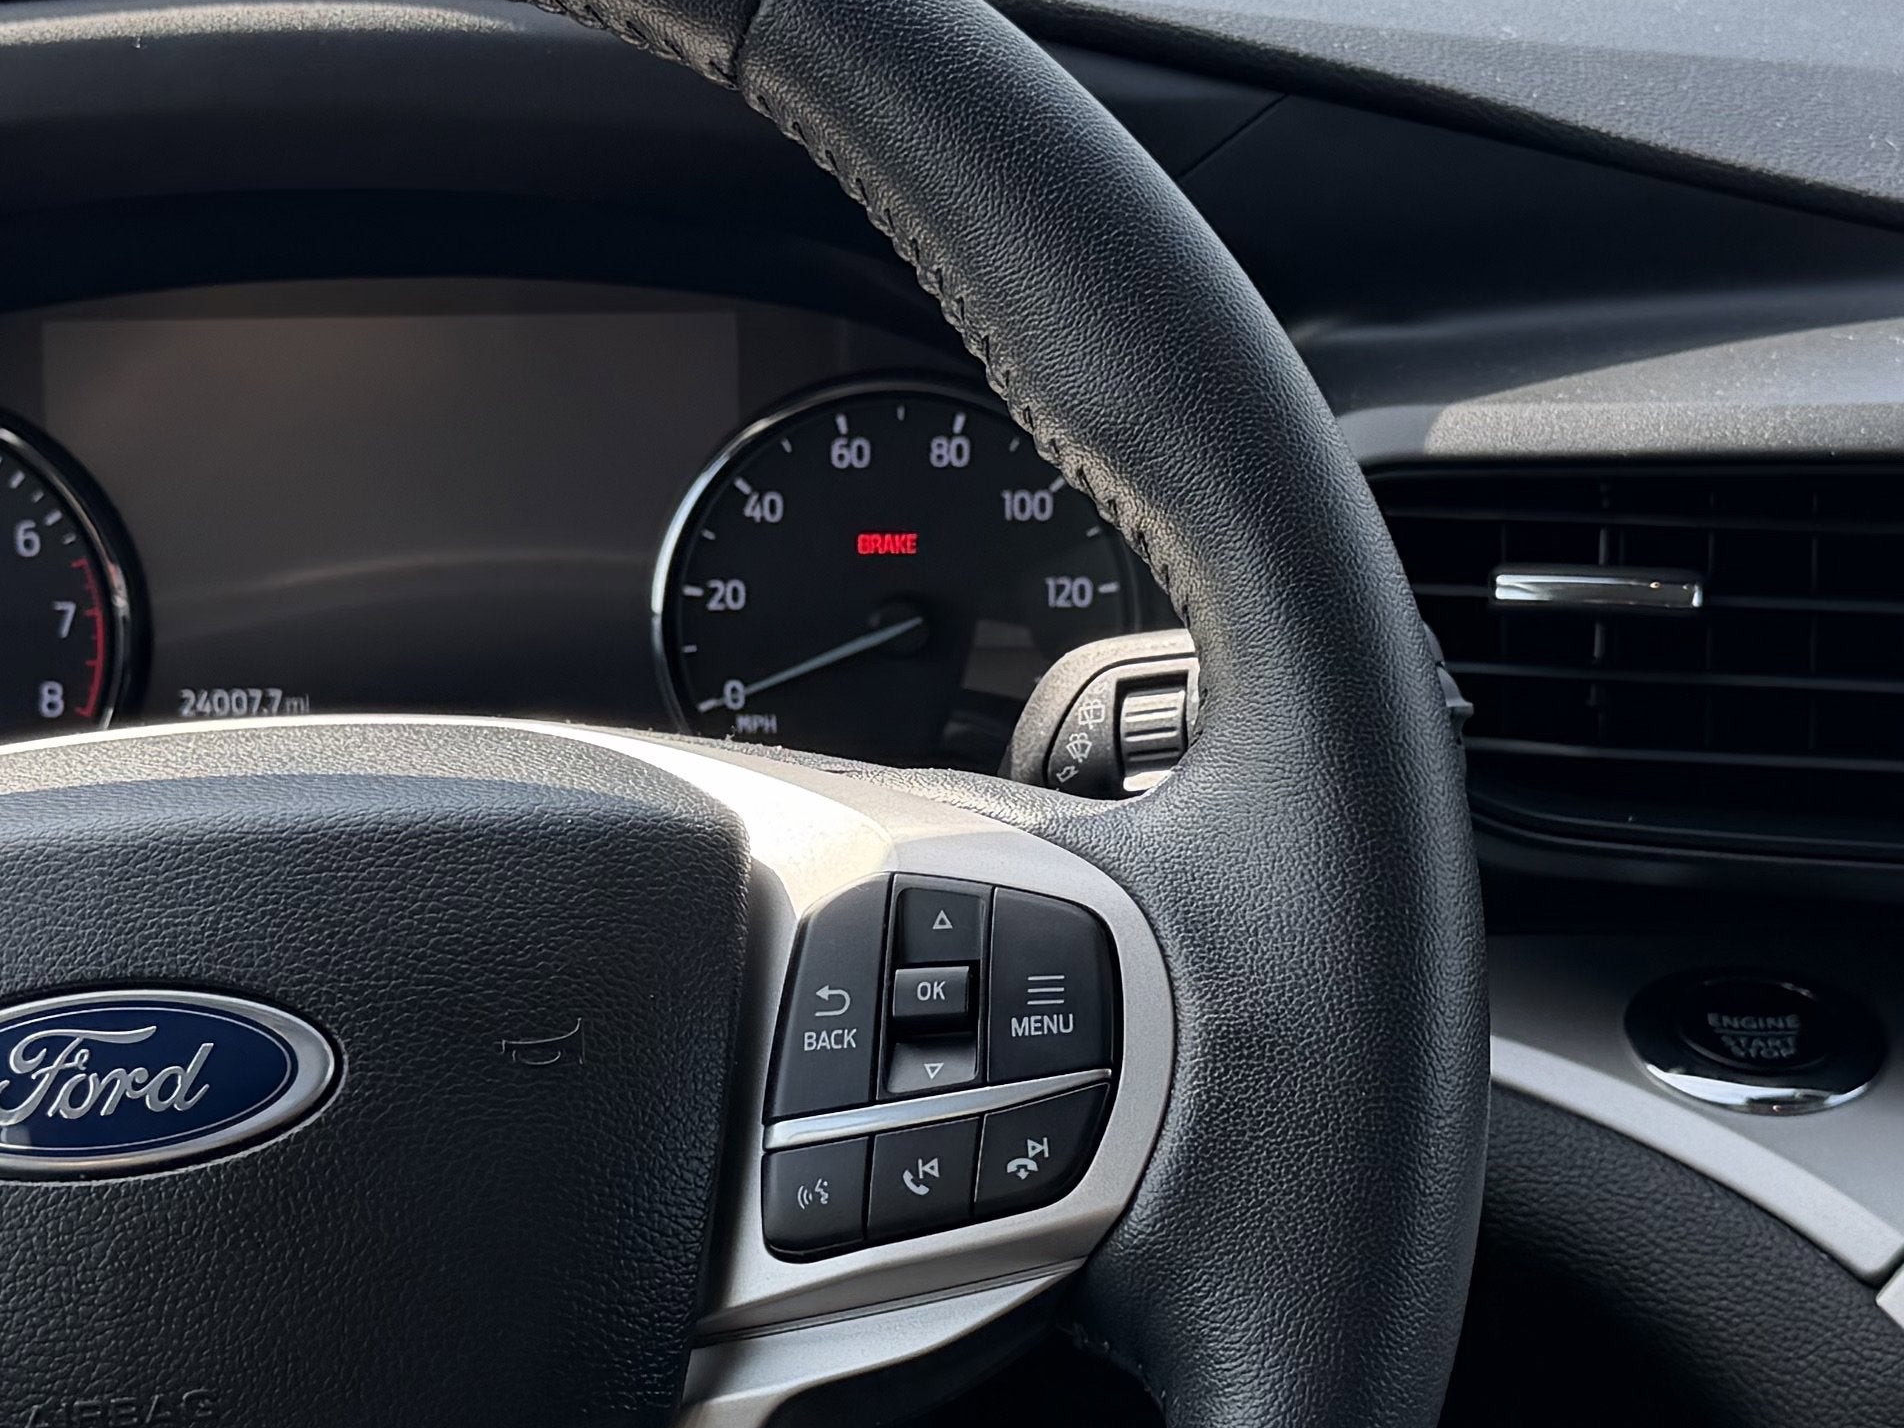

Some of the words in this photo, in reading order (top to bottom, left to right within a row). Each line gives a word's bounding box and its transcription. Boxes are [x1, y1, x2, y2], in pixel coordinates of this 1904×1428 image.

[830, 438, 871, 469] 60
[929, 436, 970, 468] 80
[744, 492, 784, 523] 40
[1002, 490, 1053, 522] 100
[14, 519, 41, 557] 6
[857, 533, 918, 555] BRAKE
[706, 579, 746, 611] 20
[1046, 577, 1093, 608] 120
[53, 600, 76, 639] 7
[39, 680, 65, 718] 8
[180, 688, 283, 717] 24007.7
[724, 679, 746, 710] 0
[737, 714, 778, 734] MPH
[916, 981, 946, 1002] OK
[1011, 1014, 1074, 1038] MENU
[1707, 1011, 1800, 1029] ENGINE
[803, 1029, 857, 1052] BACK
